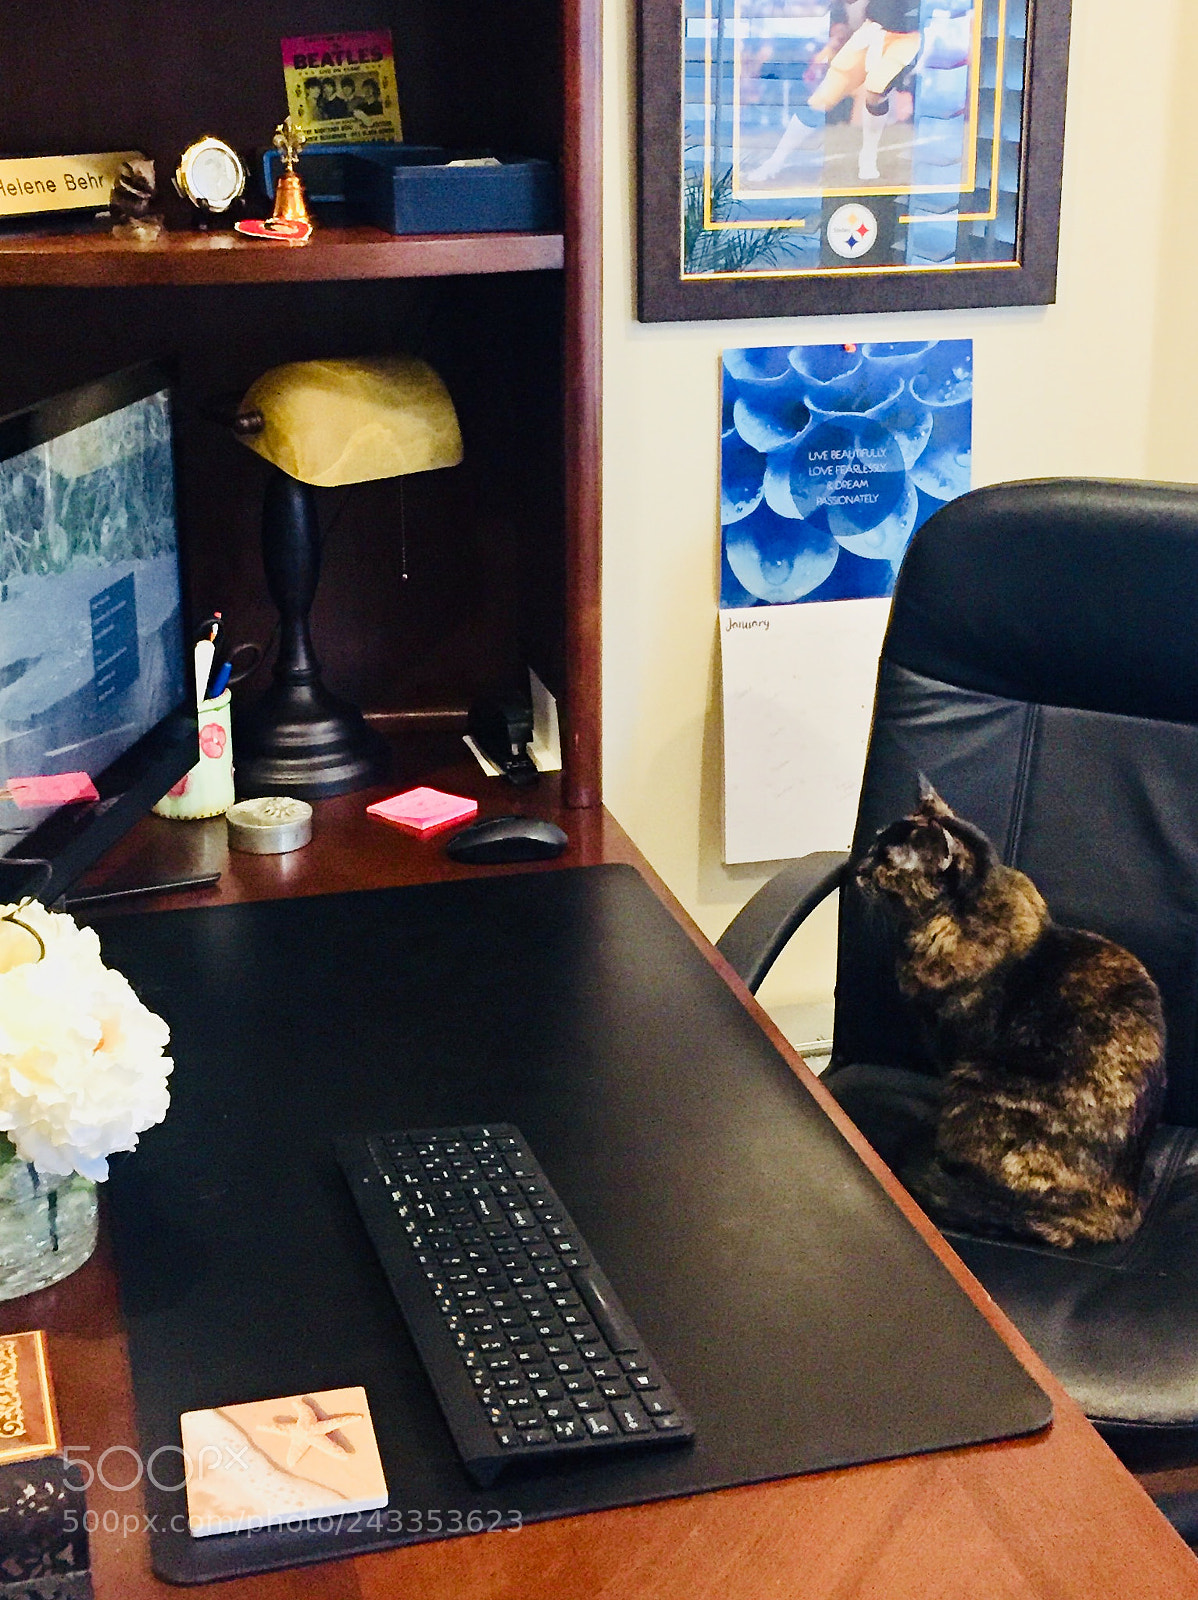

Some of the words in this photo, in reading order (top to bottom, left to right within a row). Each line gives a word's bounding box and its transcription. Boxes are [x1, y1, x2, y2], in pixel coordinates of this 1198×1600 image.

[293, 47, 383, 70] BEATLES
[63, 172, 104, 191] Behr
[808, 450, 828, 461] LIVE
[830, 448, 886, 460] BEAUTIFULLY
[808, 465, 833, 476] LOVE
[835, 464, 887, 475] FEARLESSLY
[835, 480, 869, 490] DREAM
[816, 494, 880, 506] PASSIONATELY
[726, 617, 770, 632] January
